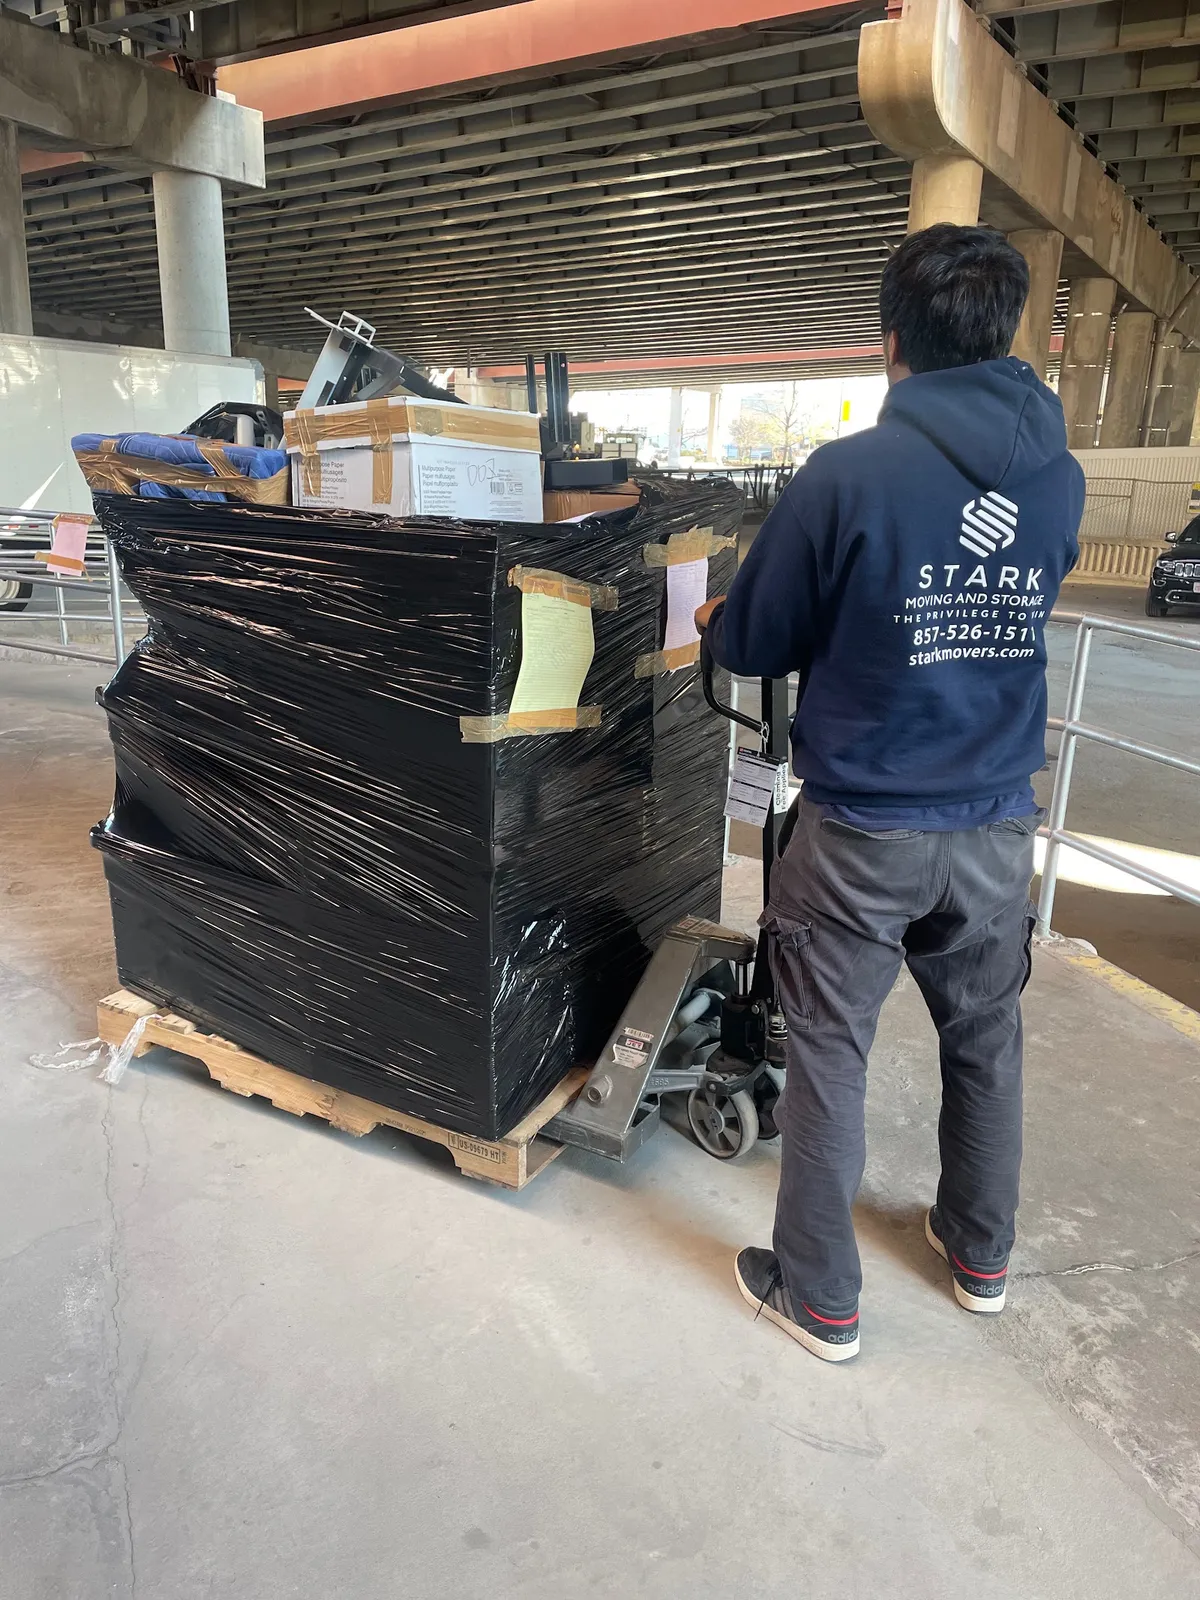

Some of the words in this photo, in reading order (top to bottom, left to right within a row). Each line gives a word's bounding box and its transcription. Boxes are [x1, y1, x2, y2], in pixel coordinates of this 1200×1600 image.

[918, 564, 1044, 591] STARK
[905, 593, 953, 609] MOVING
[955, 593, 988, 605] AND
[893, 613, 922, 624] THE
[926, 609, 999, 621] PRIVILEGE
[1008, 611, 1027, 621] TO
[908, 646, 1035, 666] starkmovers.com
[626, 1039, 643, 1049] JET
[490, 1150, 499, 1161] HT
